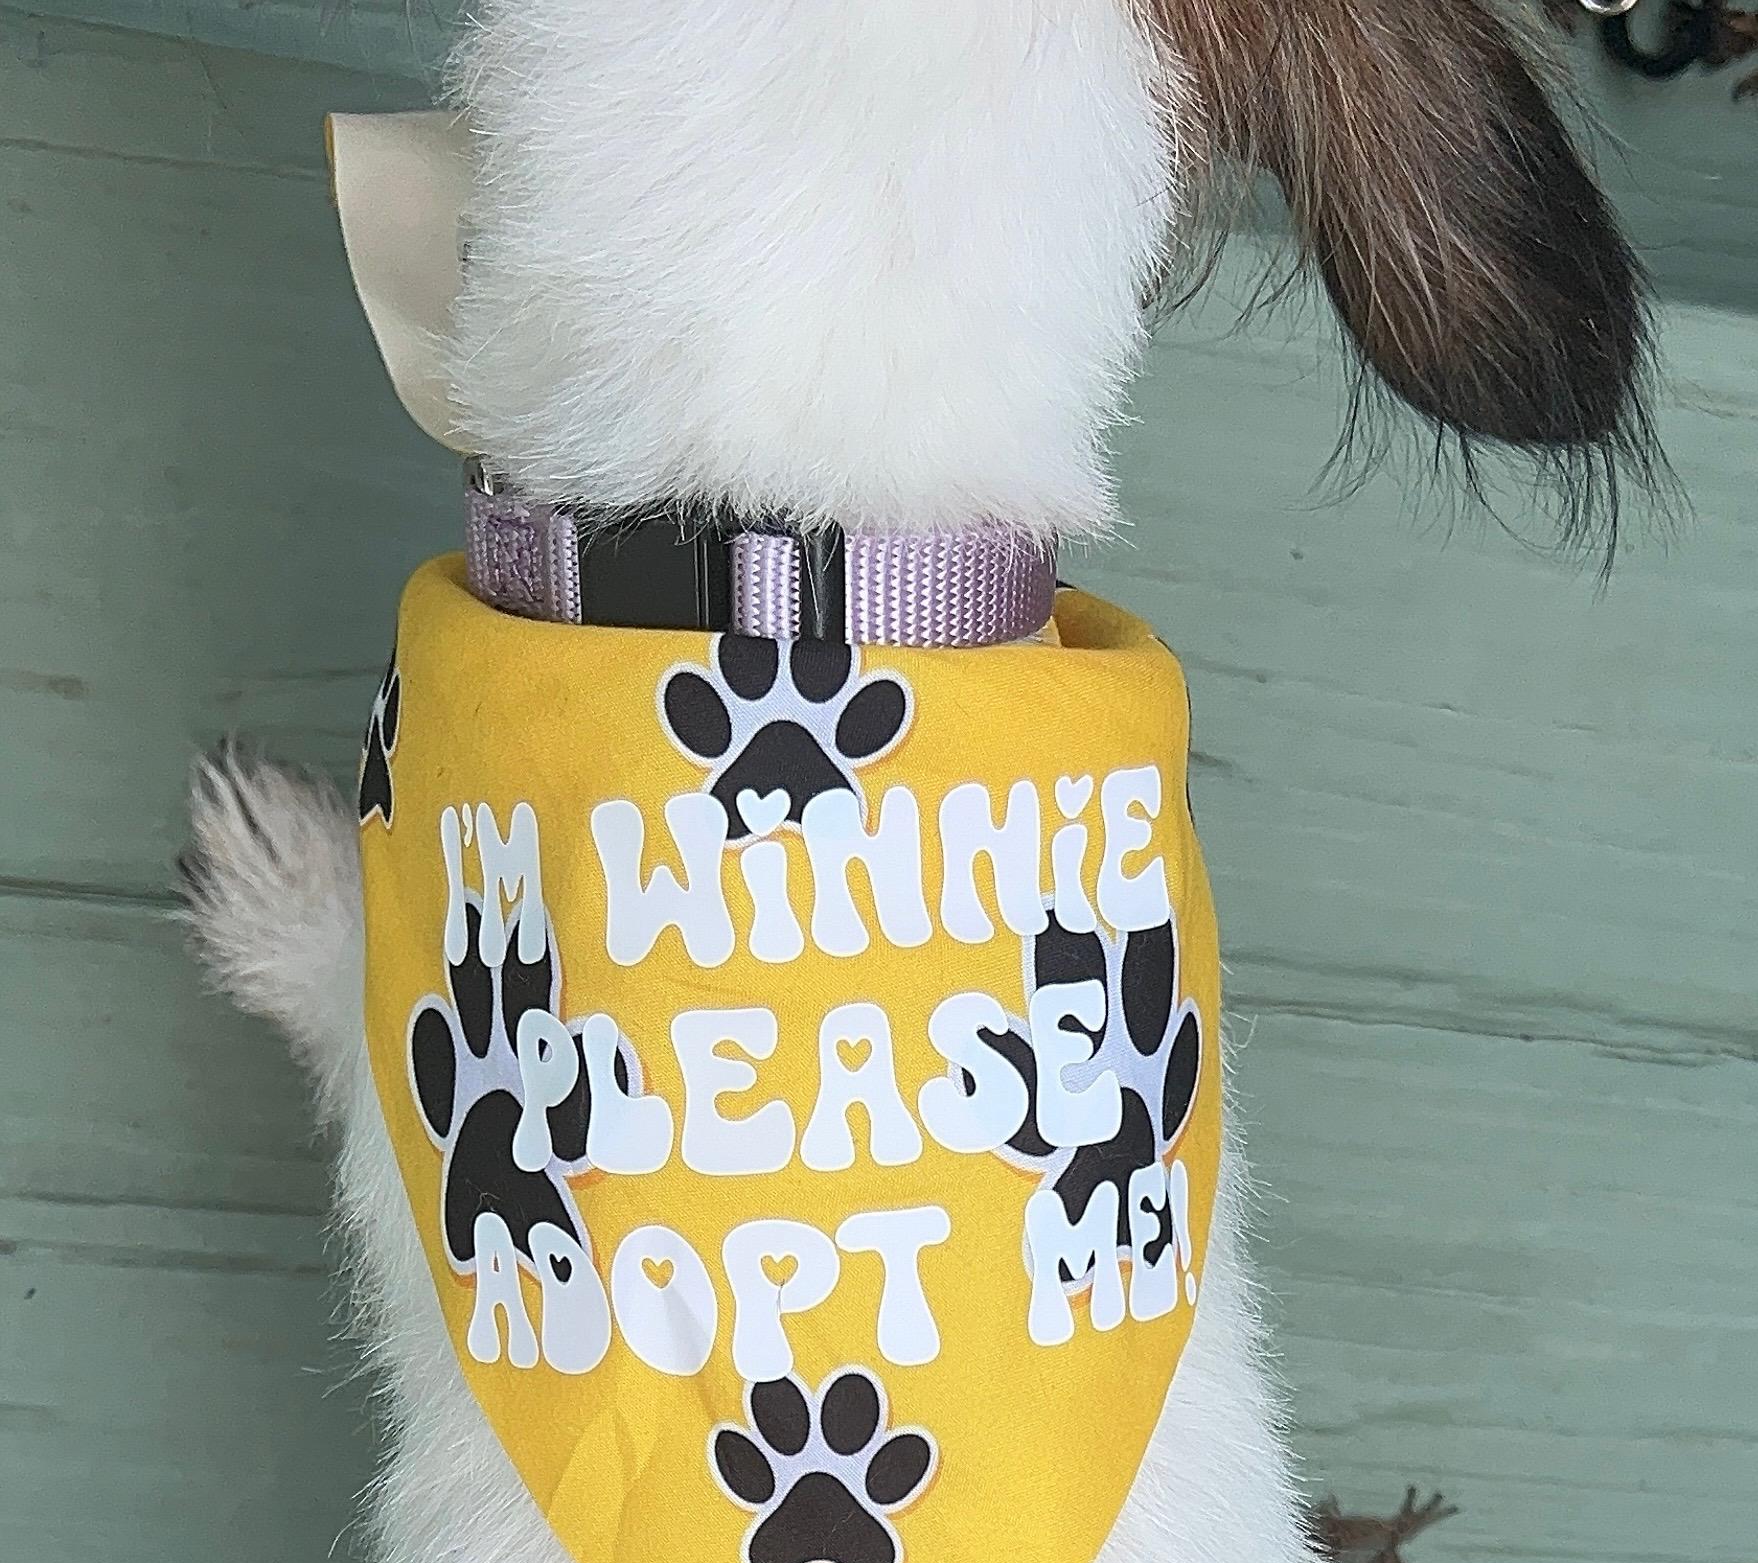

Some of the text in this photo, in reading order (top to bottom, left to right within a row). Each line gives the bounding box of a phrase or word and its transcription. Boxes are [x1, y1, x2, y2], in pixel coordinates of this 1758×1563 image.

[440, 801, 547, 968] I'M
[512, 981, 1123, 1176] PLEASE
[467, 1161, 1197, 1382] ADOPT ME!
